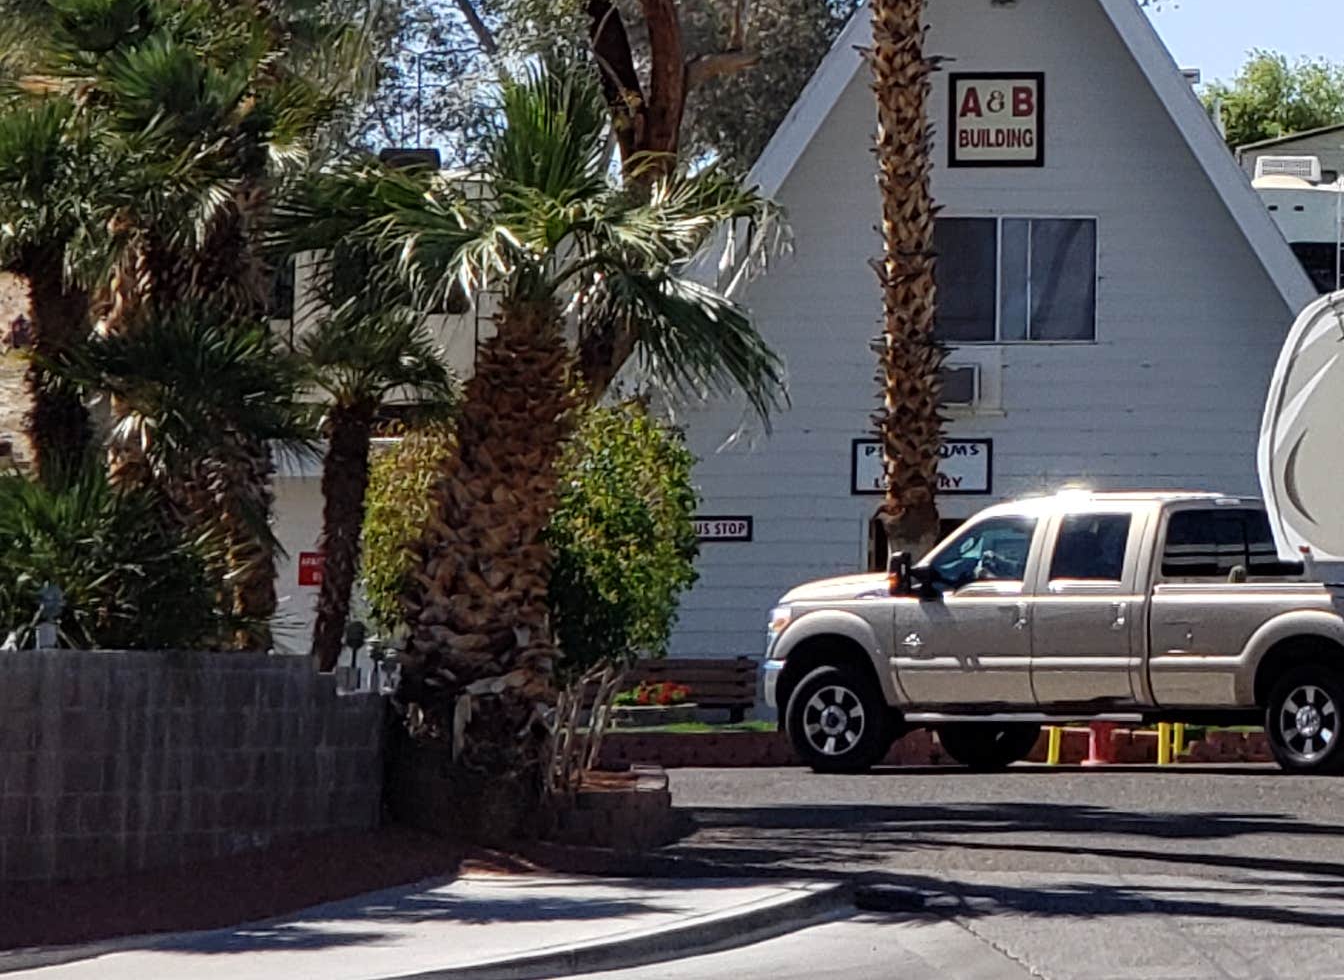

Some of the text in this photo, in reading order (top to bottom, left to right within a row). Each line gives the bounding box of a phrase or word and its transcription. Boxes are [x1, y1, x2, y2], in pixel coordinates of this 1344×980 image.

[959, 86, 1034, 117] A & B
[959, 127, 1034, 148] BUILDING
[694, 522, 745, 535] US STOP
